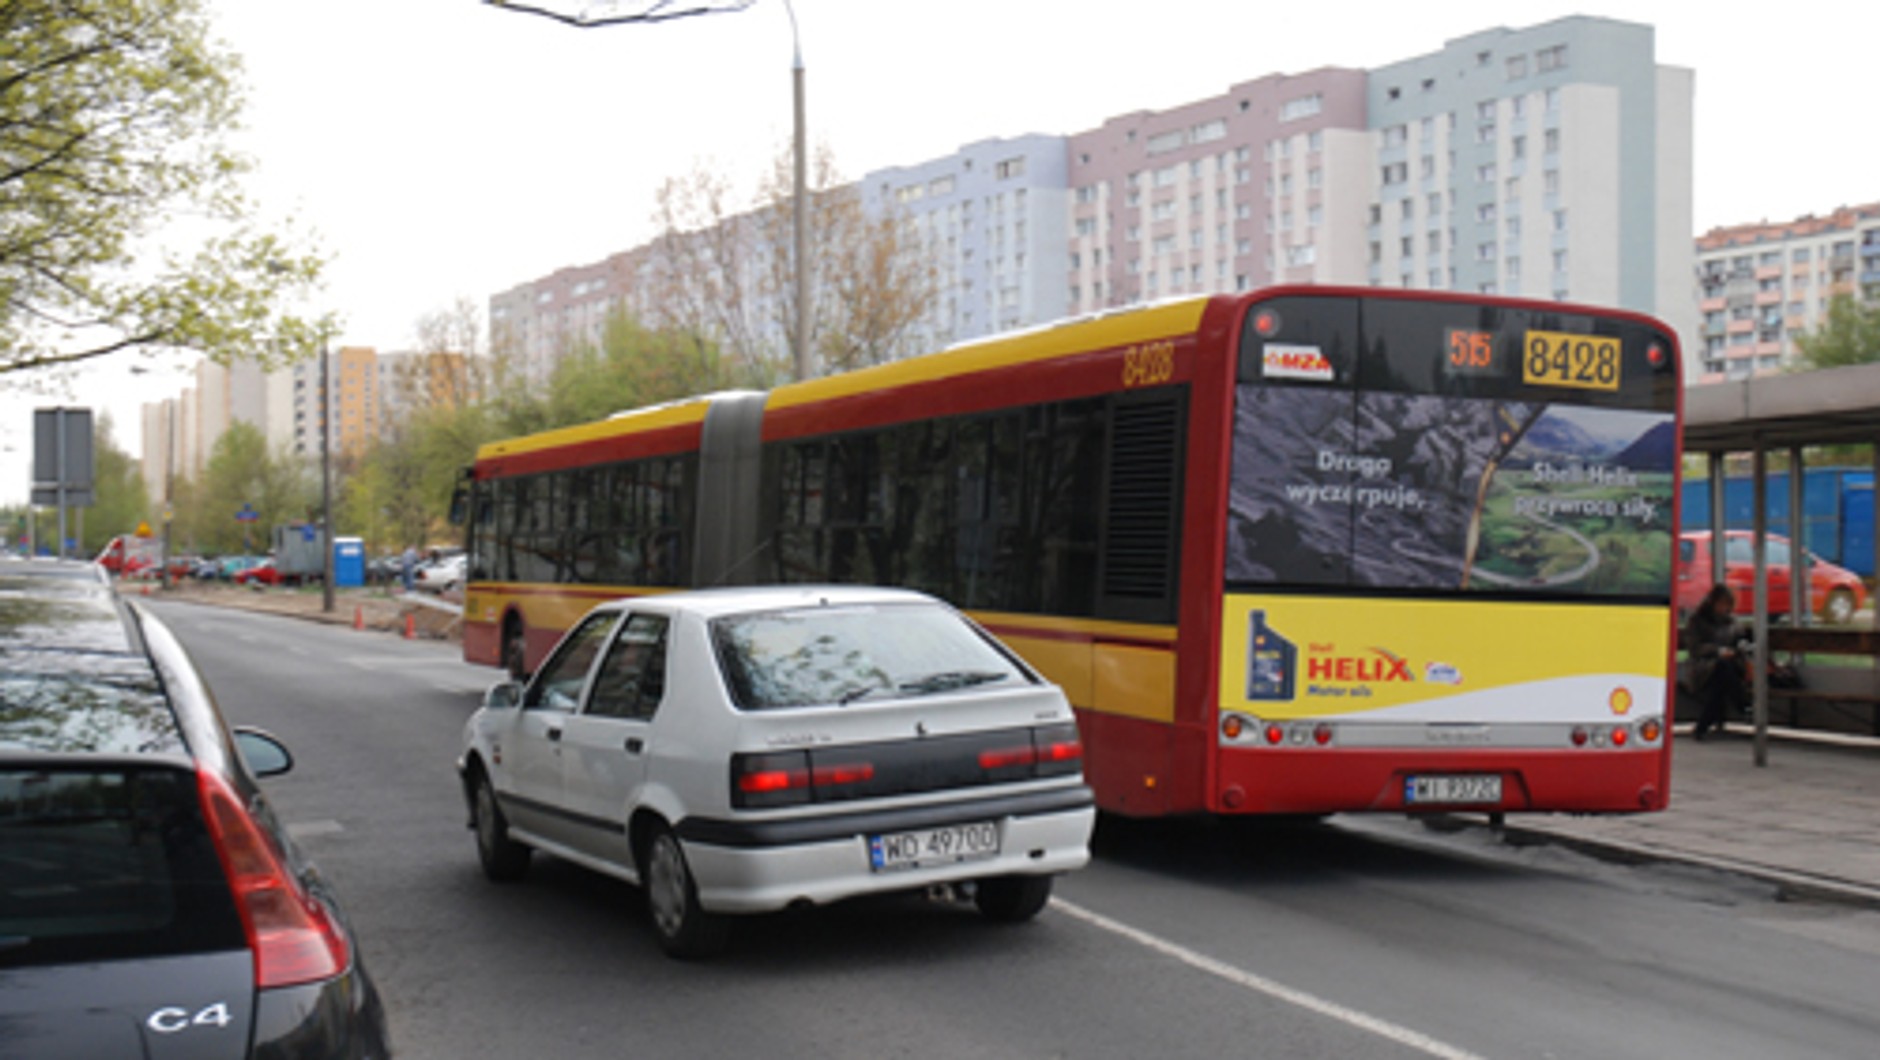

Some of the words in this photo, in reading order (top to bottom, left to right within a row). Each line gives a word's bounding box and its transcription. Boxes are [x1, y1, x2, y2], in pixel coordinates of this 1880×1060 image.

[1281, 352, 1330, 372] MZA
[1451, 329, 1492, 368] 515
[1529, 337, 1616, 385] 8428
[1308, 656, 1412, 683] HELIX
[1306, 684, 1348, 698] Motor
[886, 834, 919, 861] WD
[147, 1002, 233, 1033] C4
